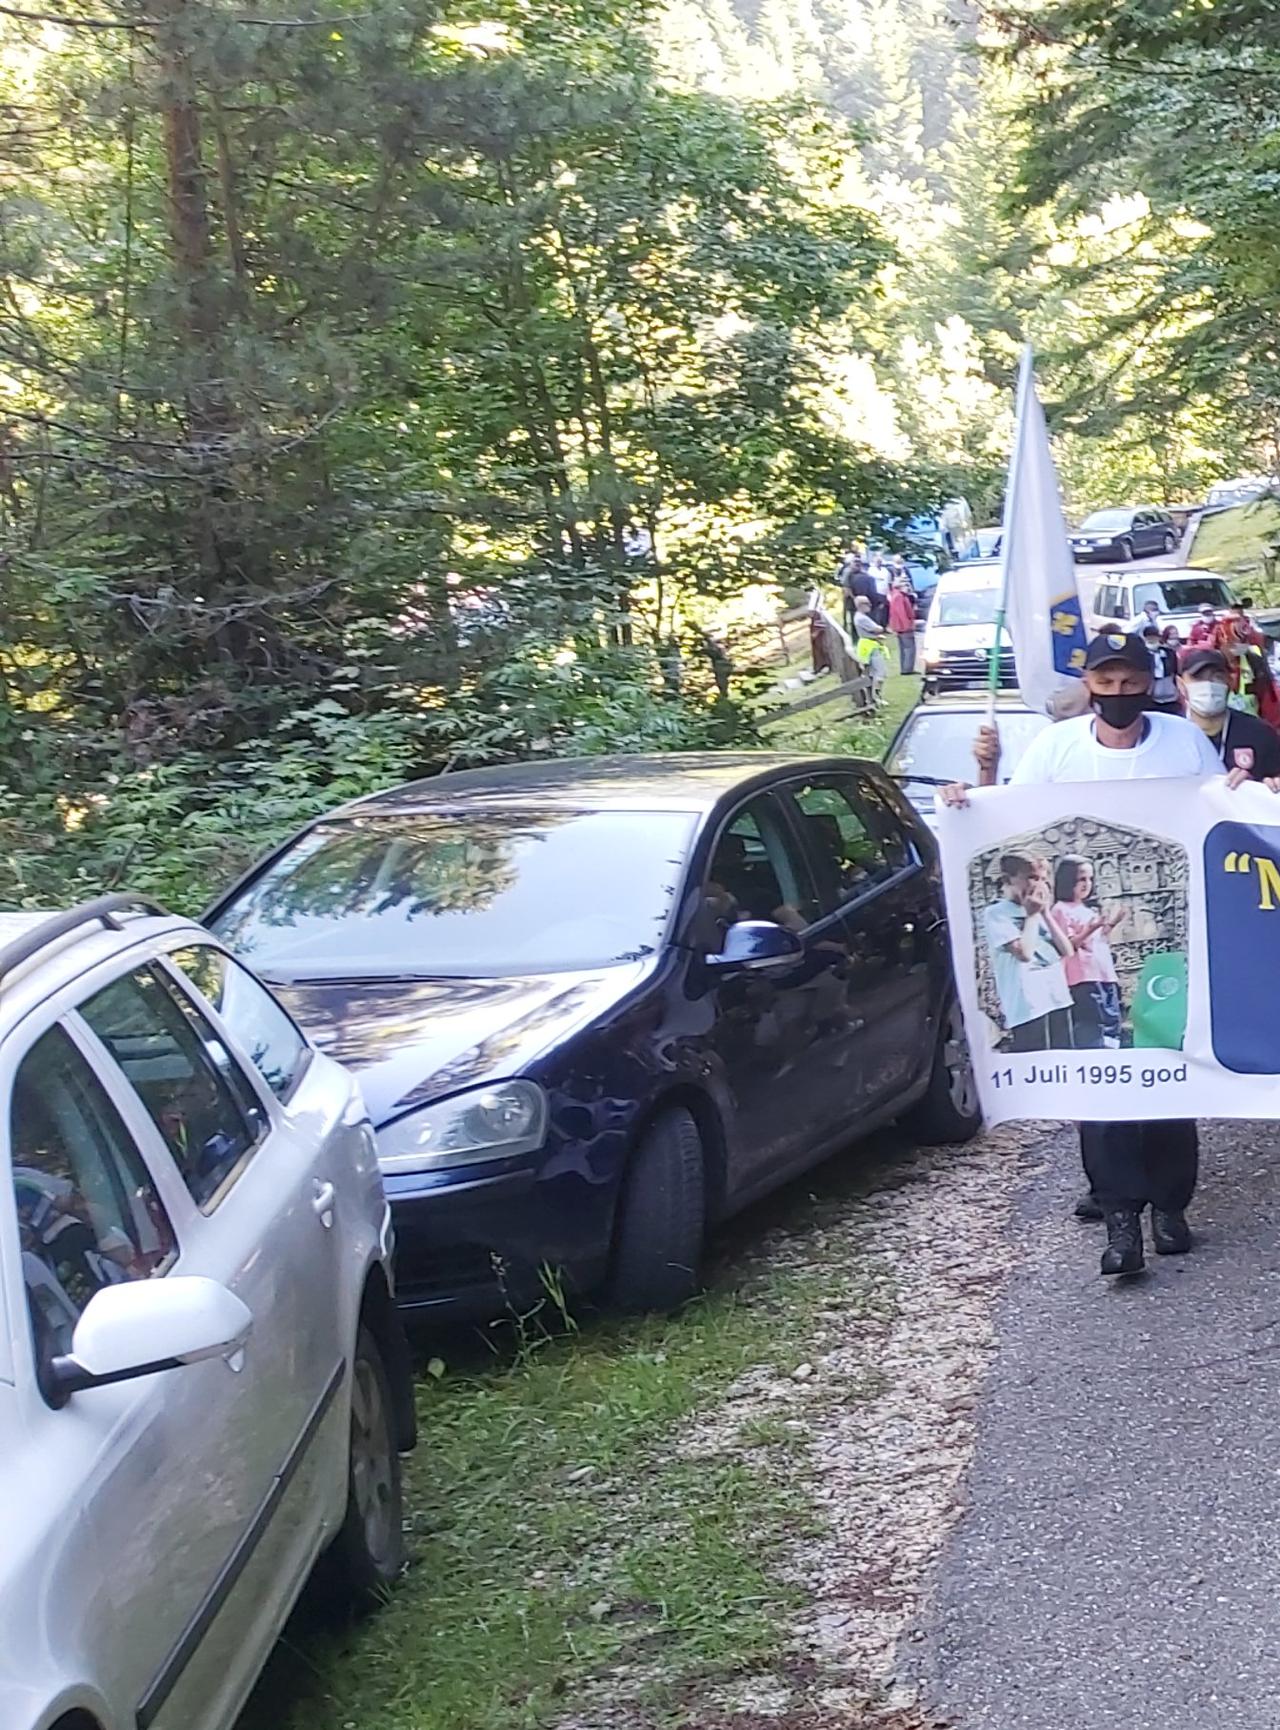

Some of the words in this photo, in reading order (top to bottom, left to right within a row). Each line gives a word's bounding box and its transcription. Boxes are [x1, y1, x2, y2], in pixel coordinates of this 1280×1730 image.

[990, 1068, 1014, 1089] 11
[1023, 1064, 1068, 1084] Juli
[1075, 1064, 1133, 1084] 1995
[1140, 1063, 1188, 1088] god
